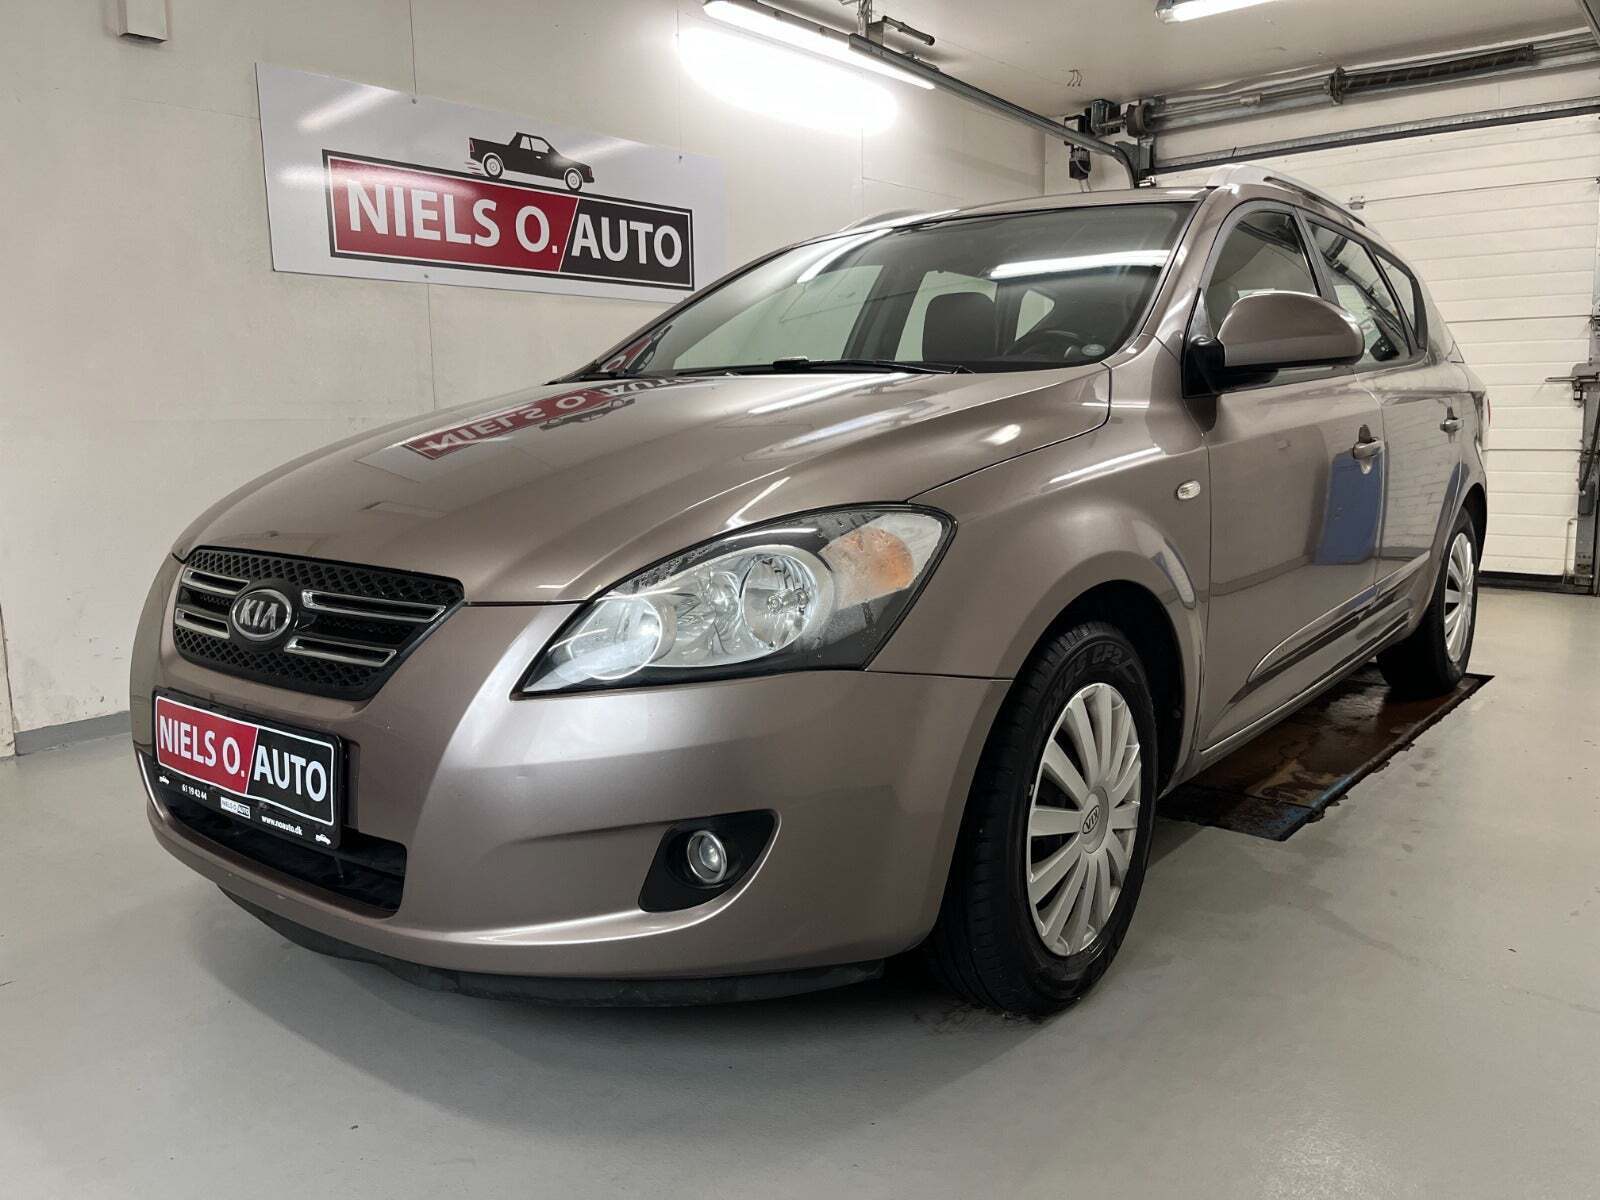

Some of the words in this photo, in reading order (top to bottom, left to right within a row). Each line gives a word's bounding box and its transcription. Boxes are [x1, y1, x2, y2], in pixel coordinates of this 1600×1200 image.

[346, 180, 501, 247] NIELS
[515, 205, 558, 254] O.
[571, 214, 683, 268] AUTO
[240, 599, 279, 631] KIA
[159, 715, 217, 767] NIELS
[222, 737, 245, 778] O.
[254, 745, 327, 802] AUTO
[261, 815, 303, 836] www.noauto.dk
[1085, 809, 1098, 829] KIA
